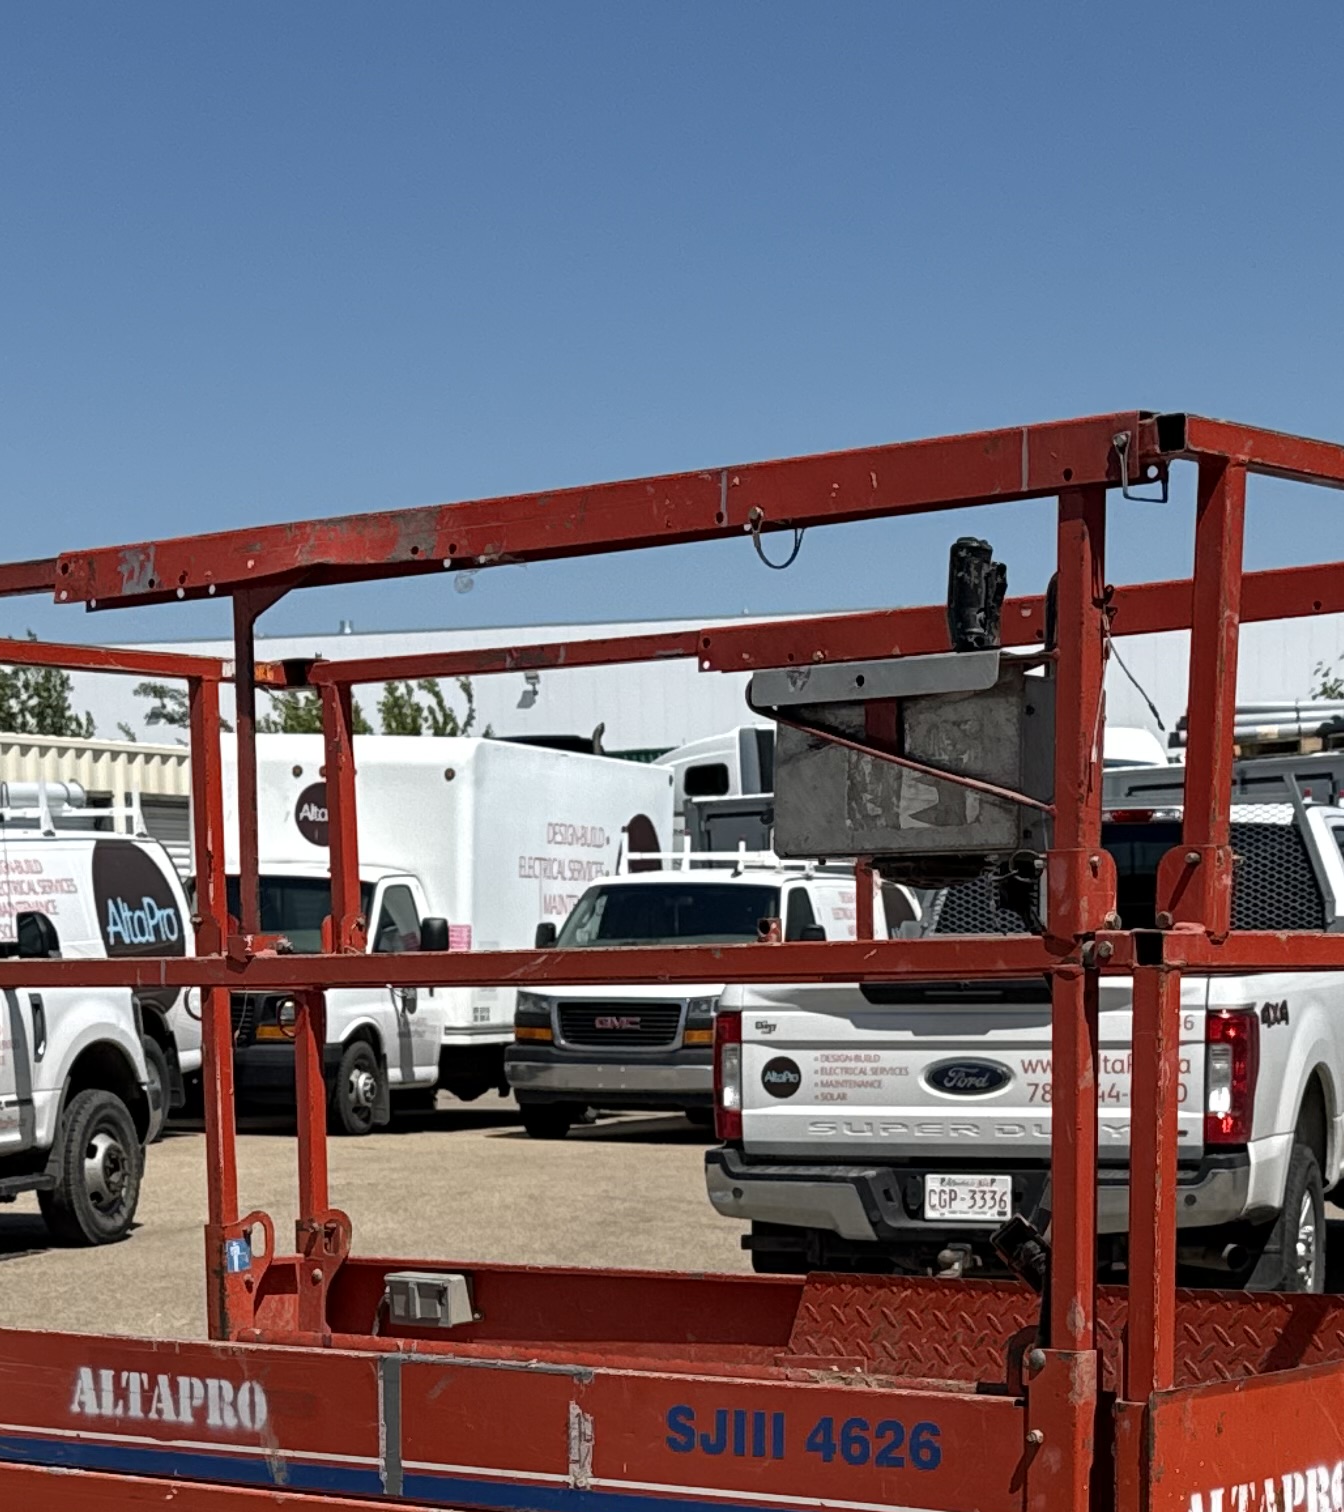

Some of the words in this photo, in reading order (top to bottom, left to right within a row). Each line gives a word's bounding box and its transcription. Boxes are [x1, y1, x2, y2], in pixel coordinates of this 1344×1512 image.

[298, 803, 329, 822] Alta
[107, 896, 179, 946] AltaPro
[764, 1070, 800, 1083] AltaPro
[942, 1066, 990, 1089] Ford
[820, 1091, 848, 1101] SOLAR
[807, 1121, 981, 1138] SUPER
[994, 1122, 1132, 1139] DUY
[928, 1188, 1008, 1210] CGP-3336
[70, 1365, 269, 1431] ALTAPRO
[665, 1403, 787, 1460] SJIII
[806, 1415, 943, 1471] 4626
